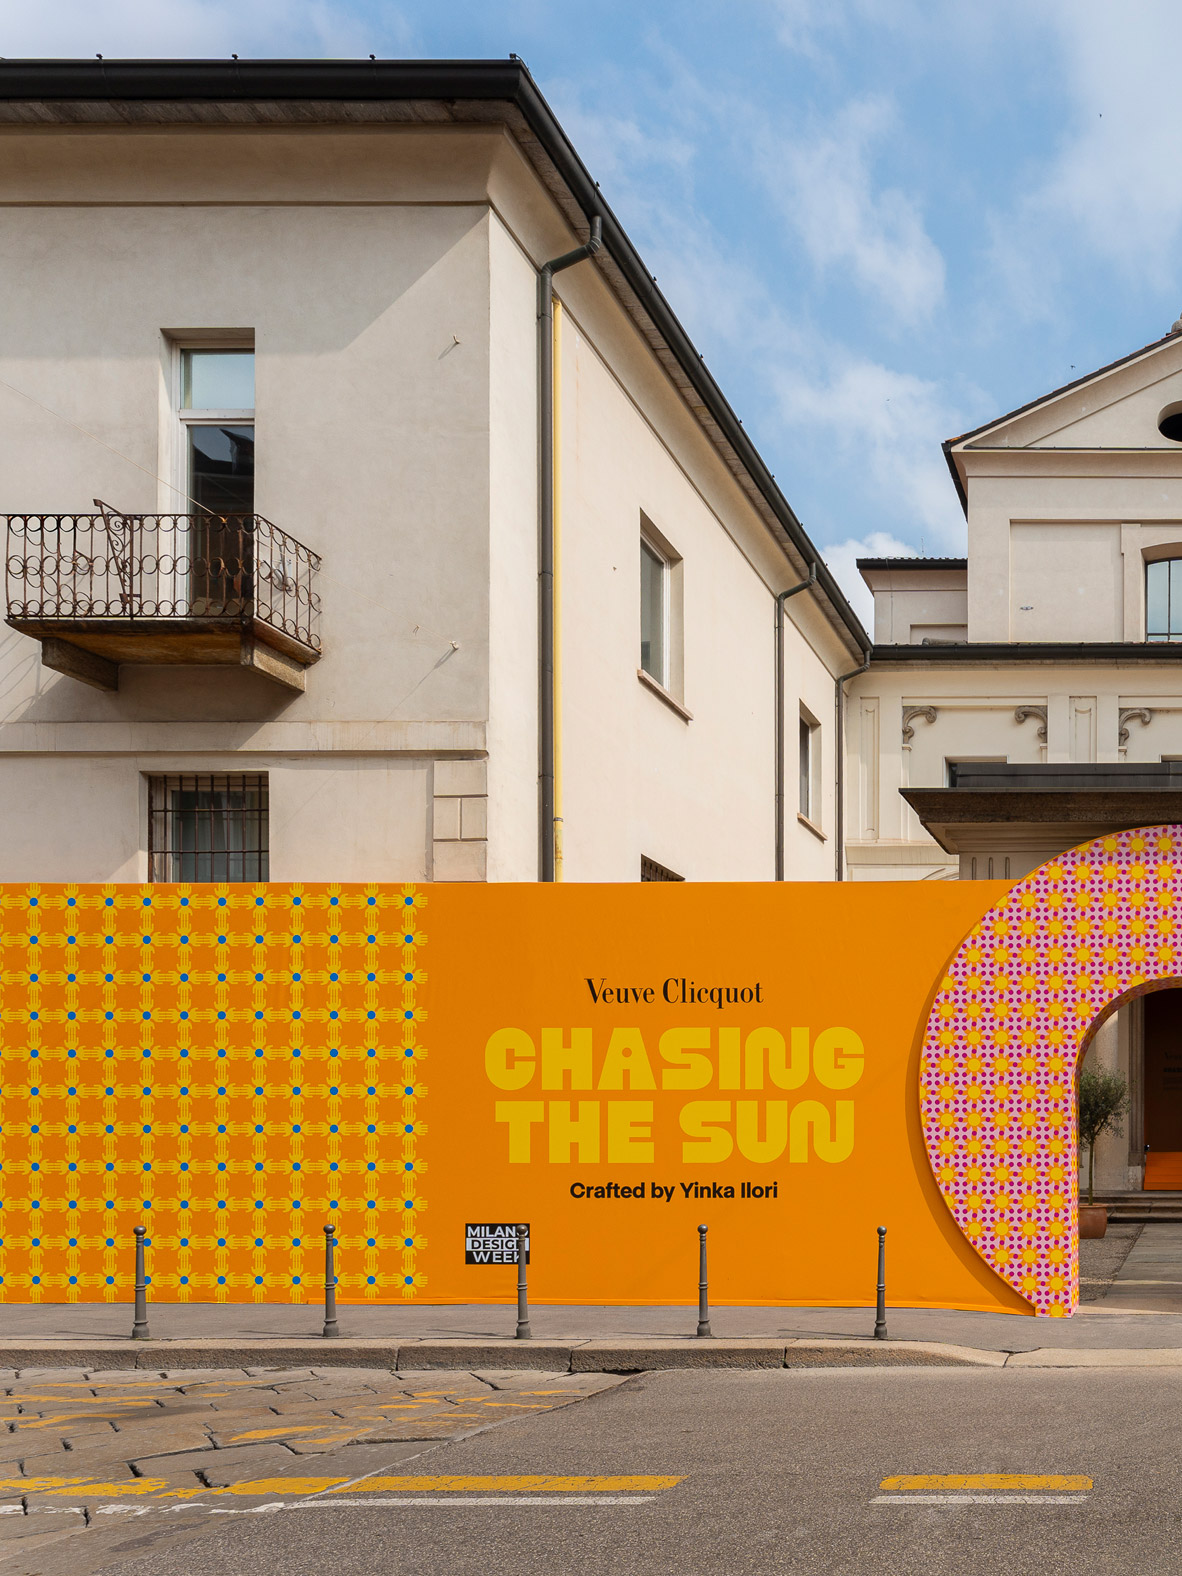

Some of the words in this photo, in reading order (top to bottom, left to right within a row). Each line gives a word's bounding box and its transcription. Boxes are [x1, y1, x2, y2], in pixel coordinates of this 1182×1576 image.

[584, 978, 656, 1004] Veuve
[662, 977, 764, 1009] Clicquot
[484, 1026, 865, 1091] CHASING
[495, 1100, 655, 1164] THE
[679, 1100, 855, 1164] SUN
[569, 1182, 646, 1199] Crafted
[651, 1182, 675, 1202] by
[679, 1182, 735, 1199] Yinka
[740, 1182, 778, 1199] Ilori
